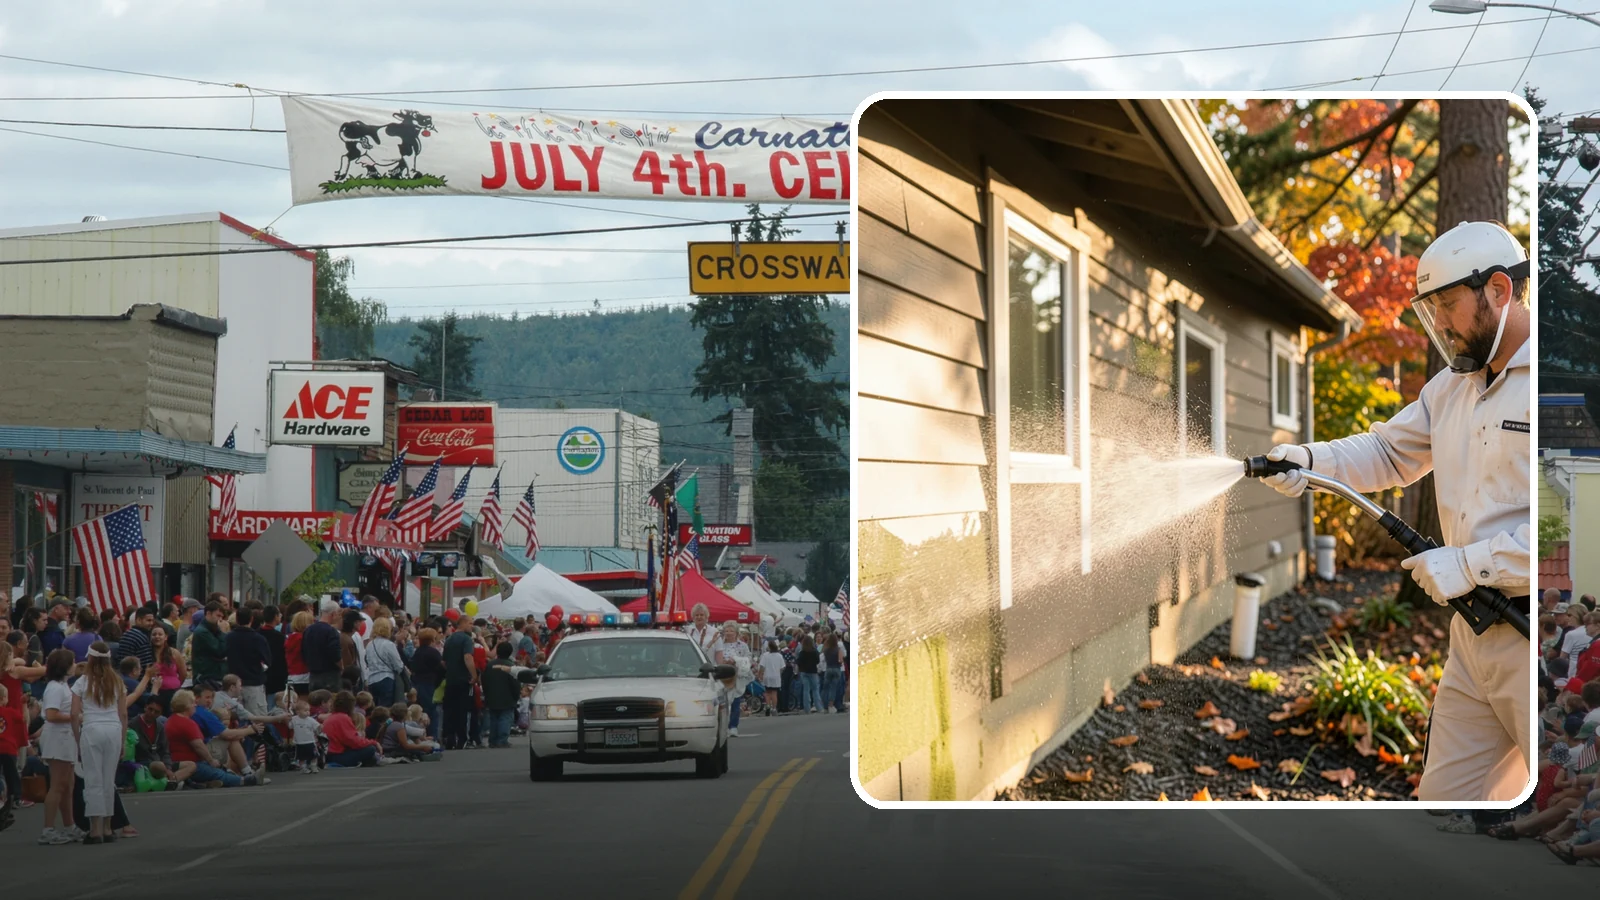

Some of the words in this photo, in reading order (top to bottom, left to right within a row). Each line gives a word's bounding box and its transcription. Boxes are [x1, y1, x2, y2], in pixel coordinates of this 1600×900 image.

[481, 141, 605, 192] JULY
[632, 150, 747, 197] 4th.
[697, 254, 851, 280] CROSSWA
[283, 380, 373, 419] ACE
[405, 409, 452, 422] CEDAR
[462, 409, 485, 421] LOG
[283, 421, 371, 436] Hardware
[416, 428, 477, 447] Coca-Cola
[82, 484, 94, 494] St.
[95, 485, 124, 495] Vincent
[126, 486, 136, 495] de
[137, 486, 155, 495] Paul
[81, 503, 154, 522] THT
[212, 517, 330, 536] HARDARE
[688, 526, 742, 535] CRNATION
[699, 535, 730, 543] GLASS
